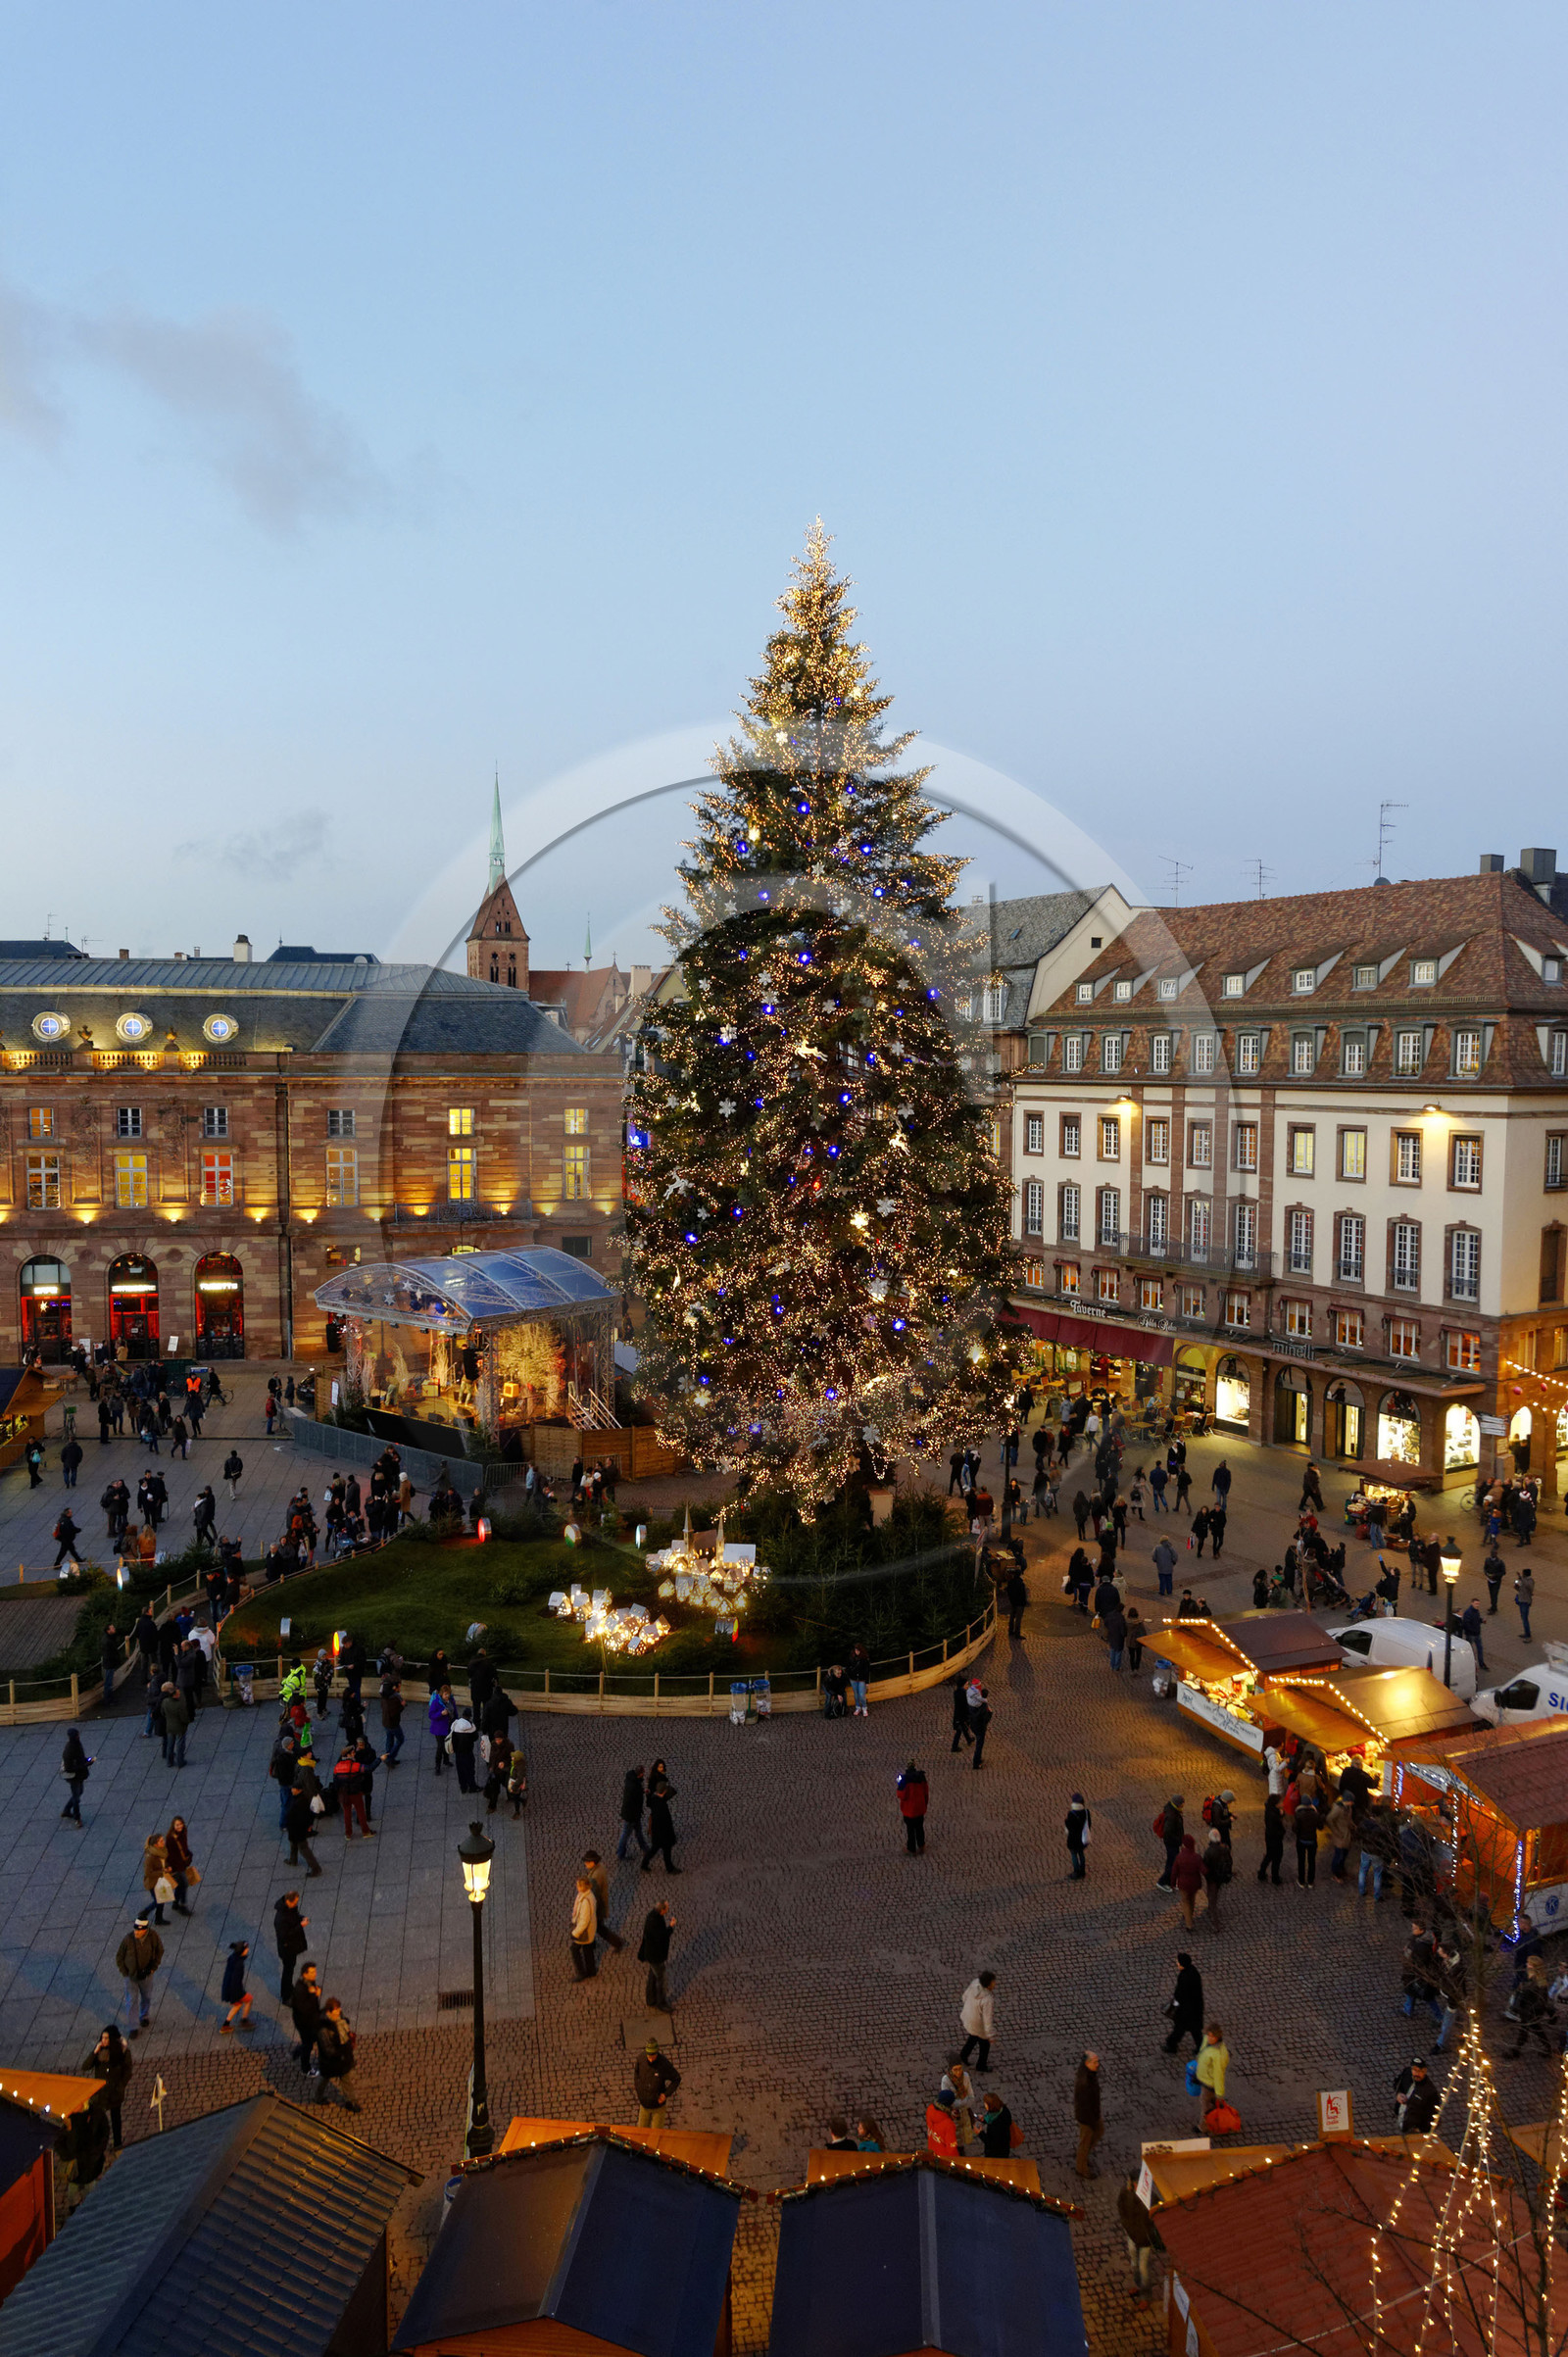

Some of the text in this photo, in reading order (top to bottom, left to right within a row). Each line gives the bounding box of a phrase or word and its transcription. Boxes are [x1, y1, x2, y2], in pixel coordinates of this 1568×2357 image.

[1070, 1300, 1106, 1318] Taverne
[1273, 1343, 1315, 1360] minelli
[1548, 1692, 1568, 1711] SI
